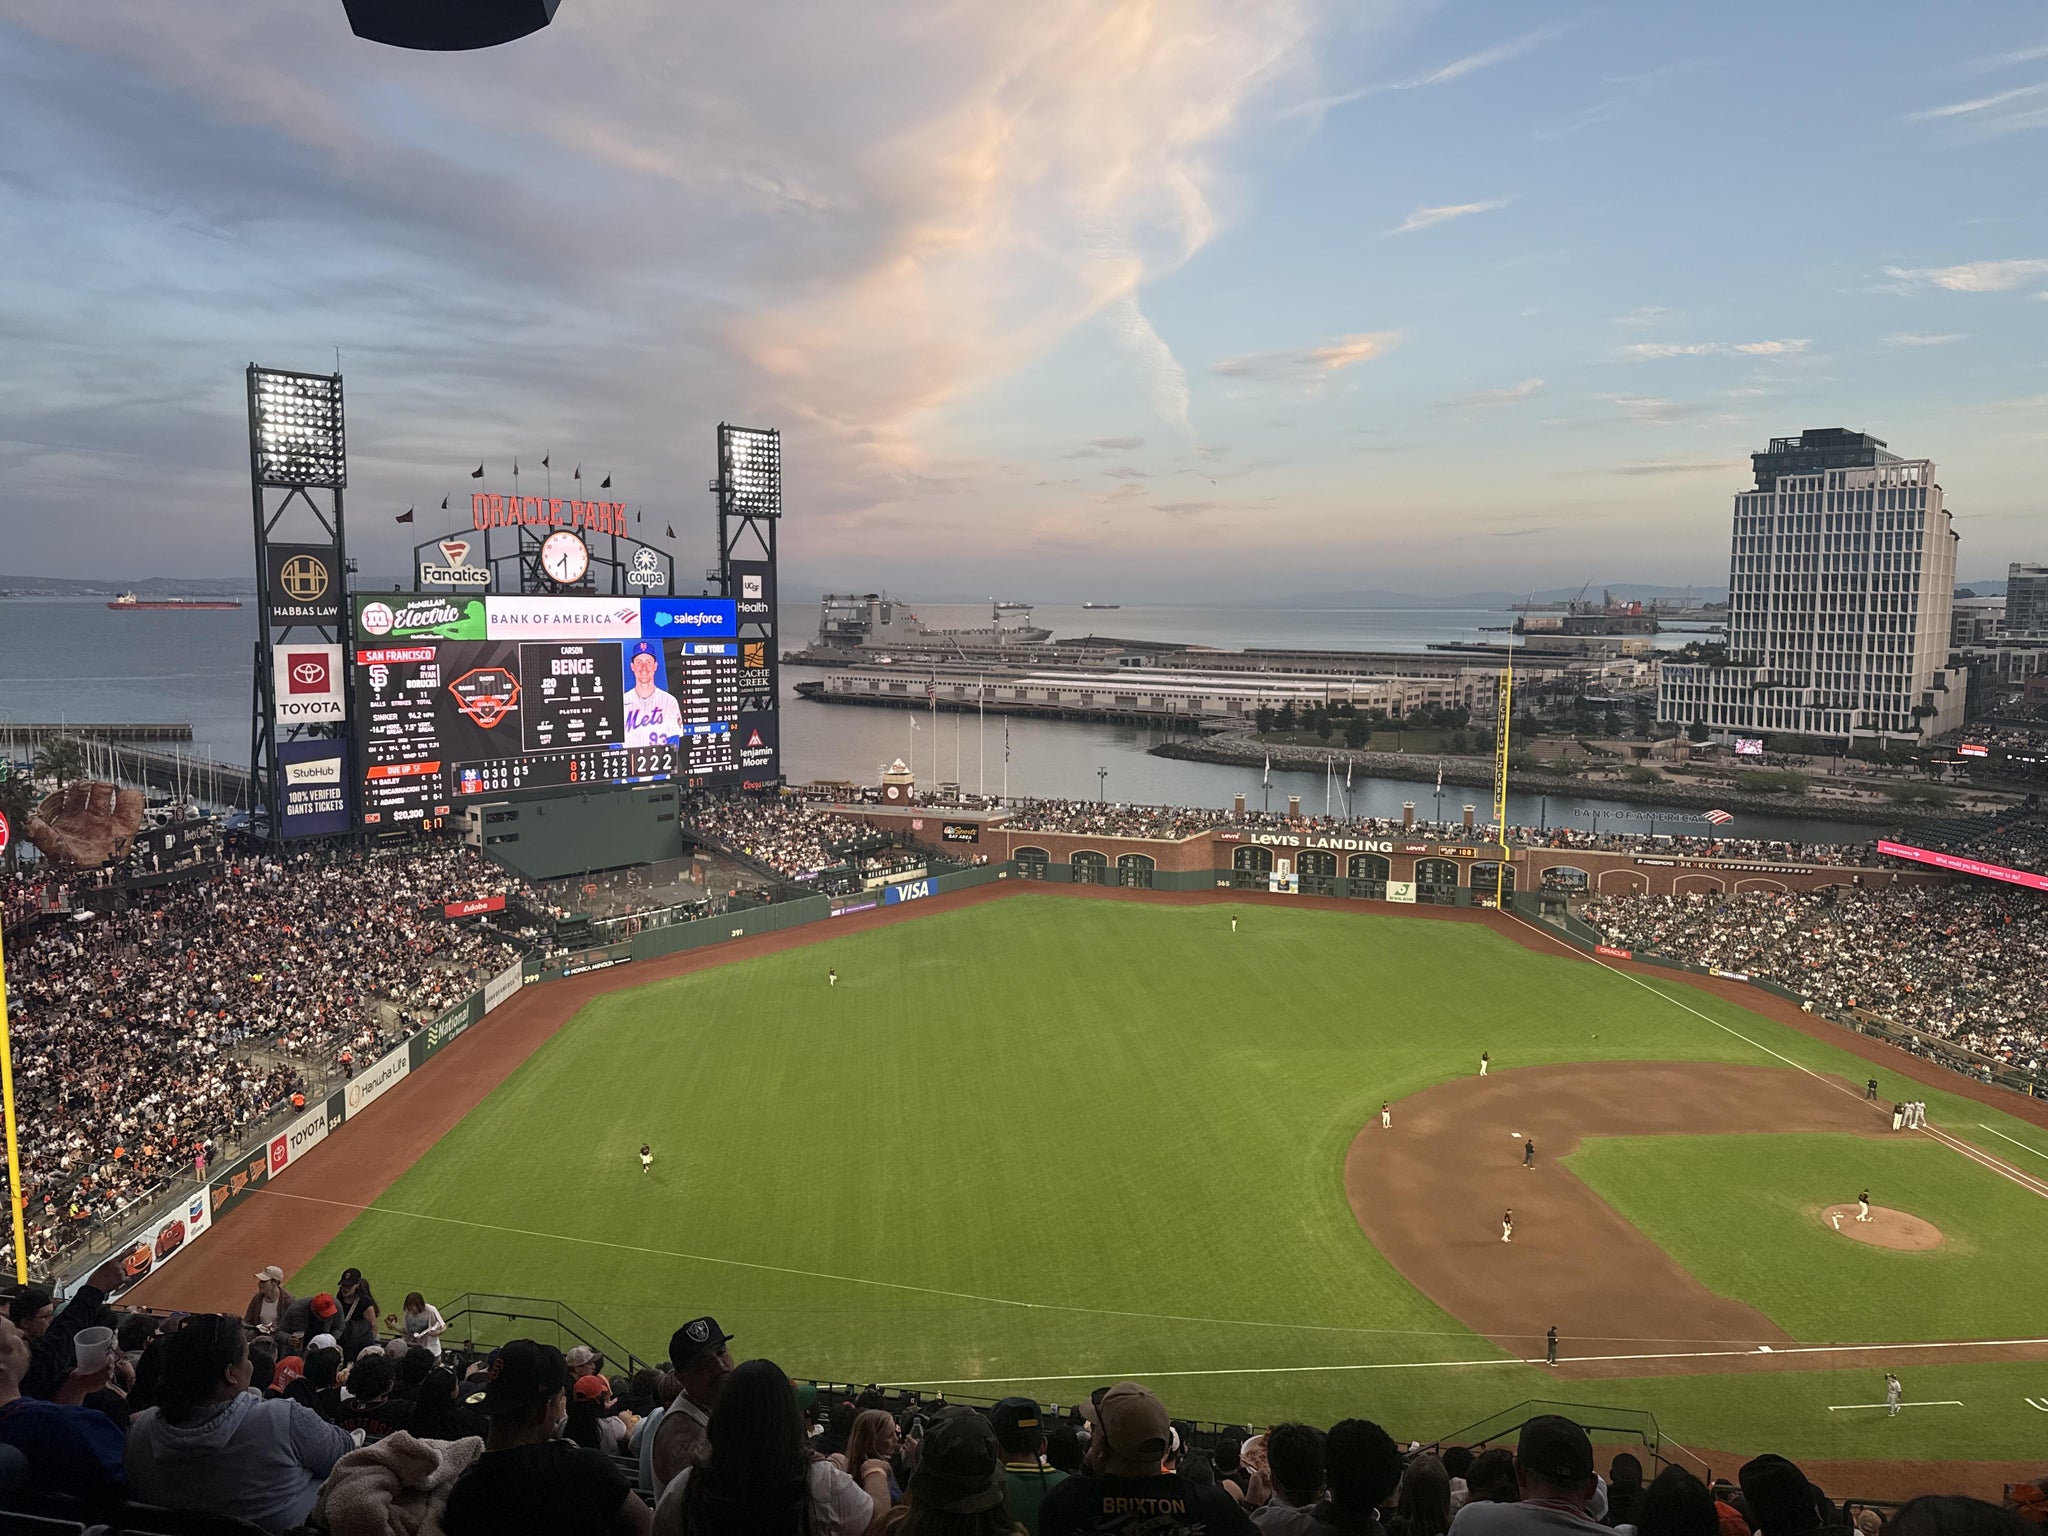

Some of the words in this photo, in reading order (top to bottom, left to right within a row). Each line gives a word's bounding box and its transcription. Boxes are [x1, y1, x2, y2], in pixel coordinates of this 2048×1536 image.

[473, 493, 564, 530] ORACLE
[570, 500, 628, 538] PARK
[424, 565, 488, 582] Fanatics
[629, 572, 662, 586] coupa
[744, 582, 760, 592] UCSF
[273, 606, 315, 616] HABBAS
[316, 606, 338, 616] LAW
[737, 601, 769, 613] Health
[394, 604, 459, 628] Electric
[491, 614, 529, 624] BANK
[533, 614, 550, 624] OF
[553, 614, 612, 624] AMERICA
[674, 612, 723, 627] salesforce
[366, 651, 384, 662] SAN
[385, 649, 432, 661] FRANCISCO
[561, 646, 583, 655] CARSON
[694, 644, 708, 654] NEW
[708, 644, 725, 654] YORK
[551, 659, 594, 675] BENGE
[739, 669, 770, 678] CACHE
[420, 671, 436, 679] RYAN
[739, 678, 769, 687] CREEK
[280, 702, 341, 715] TOYOTA
[372, 713, 398, 722] SINKER
[624, 706, 664, 733] Mets
[482, 769, 490, 779] 0
[491, 768, 499, 778] 3
[500, 767, 507, 778] 0
[513, 766, 520, 777] 0
[522, 765, 529, 776] 5
[570, 760, 577, 771] 8
[580, 760, 586, 770] 9
[590, 760, 595, 770] 1
[603, 758, 609, 768] 2
[612, 757, 618, 767] 4
[621, 757, 627, 766] 2
[637, 756, 646, 772] 2
[649, 755, 659, 771] 2
[662, 753, 672, 770] 2
[742, 758, 768, 767] Moore
[293, 766, 334, 779] StubHub
[387, 765, 400, 775] DUE
[401, 765, 411, 773] UP
[379, 777, 400, 786] BAILEY
[483, 780, 490, 790] 0
[492, 779, 499, 789] 0
[501, 778, 508, 788] 0
[513, 777, 520, 787] 0
[570, 770, 577, 782] 0
[580, 771, 586, 781] 2
[589, 770, 596, 780] 2
[603, 769, 609, 778] 4
[612, 768, 618, 777] 2
[621, 767, 627, 777] 2
[761, 780, 778, 788] LIGHT
[288, 790, 309, 803] 100%
[309, 788, 341, 801] VERIFIED
[380, 797, 405, 806] ADAMES
[287, 802, 316, 816] GIANTS
[314, 799, 344, 813] TICKETS
[393, 808, 424, 821] $20,300
[1573, 807, 1610, 819] BANK
[1615, 810, 1631, 819] OF
[1636, 813, 1699, 823] AMERICA
[423, 817, 442, 830] 0:17
[953, 826, 977, 836] Sports
[1306, 836, 1393, 853] LANDING
[1935, 856, 1948, 864] What
[1948, 858, 1962, 868] would
[1962, 862, 1970, 870] you
[1971, 863, 1979, 872] like
[1980, 865, 1989, 874] the
[1989, 868, 2005, 878] power
[895, 880, 929, 902] VISA
[463, 902, 488, 913] Adobe
[1481, 900, 1497, 908] 309
[731, 928, 743, 937] 391
[1600, 947, 1627, 958] ORACLE
[570, 965, 592, 975] KONICA
[591, 960, 615, 970] MINOLTA
[523, 973, 540, 984] 399
[438, 1003, 469, 1040] National
[361, 1069, 392, 1098] Hanwha
[393, 1057, 407, 1075] Life
[328, 1113, 342, 1131] 354
[290, 1115, 326, 1149] TOYOTA
[1103, 1497, 1186, 1514] BRIXTON
